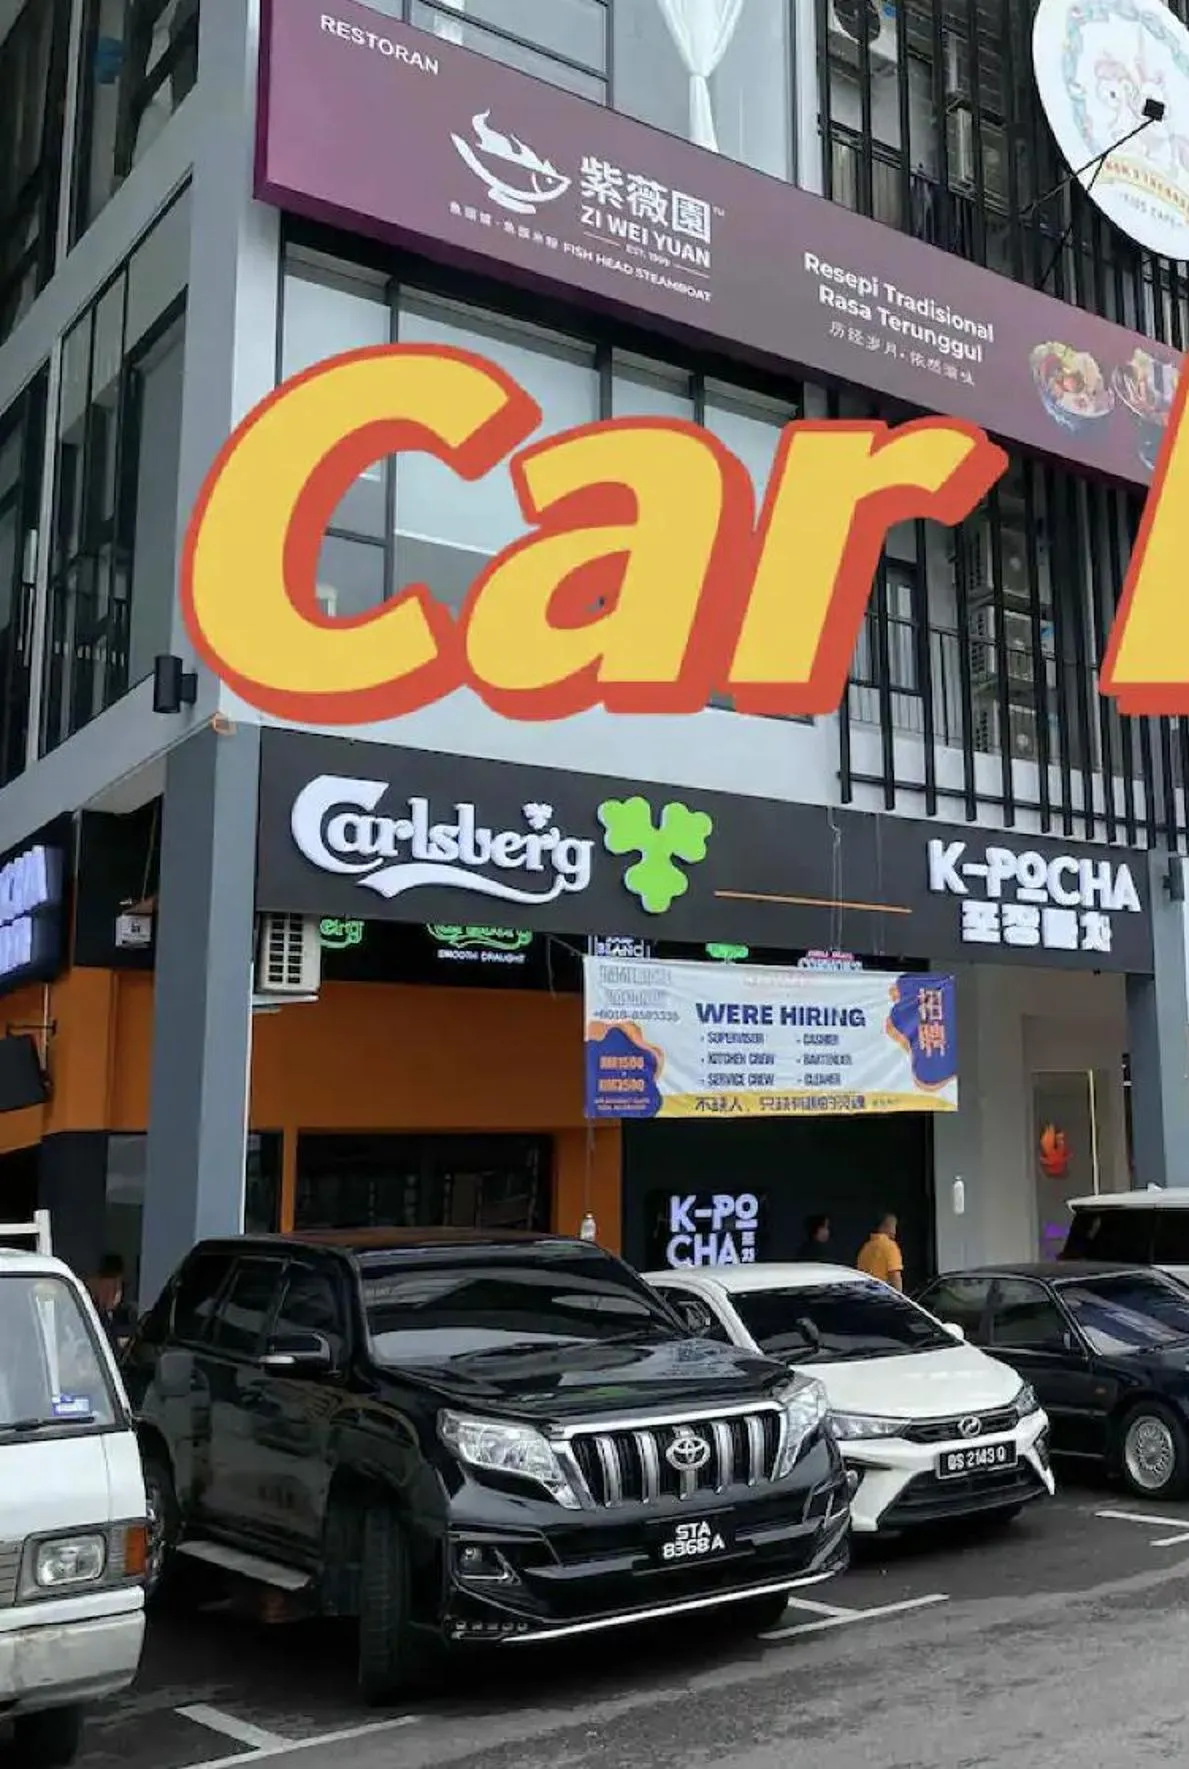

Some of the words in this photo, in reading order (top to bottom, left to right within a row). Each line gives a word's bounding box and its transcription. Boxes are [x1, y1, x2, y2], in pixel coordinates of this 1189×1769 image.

[320, 13, 439, 76] RESTORAN
[580, 156, 711, 244] 紫薇園
[580, 205, 601, 228] ZI
[607, 214, 649, 246] WEI
[654, 230, 711, 269] YUAN
[563, 242, 593, 261] FISH
[596, 251, 633, 274] HEAD
[635, 264, 712, 302] STEAMBOAT
[804, 252, 880, 298] Resepi
[882, 283, 995, 343] Tradisional
[818, 284, 873, 321] Rasa
[876, 306, 983, 362] Terunggul
[291, 774, 595, 902] Carlsberg
[927, 839, 1141, 912] K-POCHA
[695, 1002, 774, 1026] WERE
[780, 1005, 867, 1027] HIRING
[669, 1193, 759, 1232] K-PO
[666, 1232, 738, 1269] CHA
[675, 1521, 711, 1540] STA
